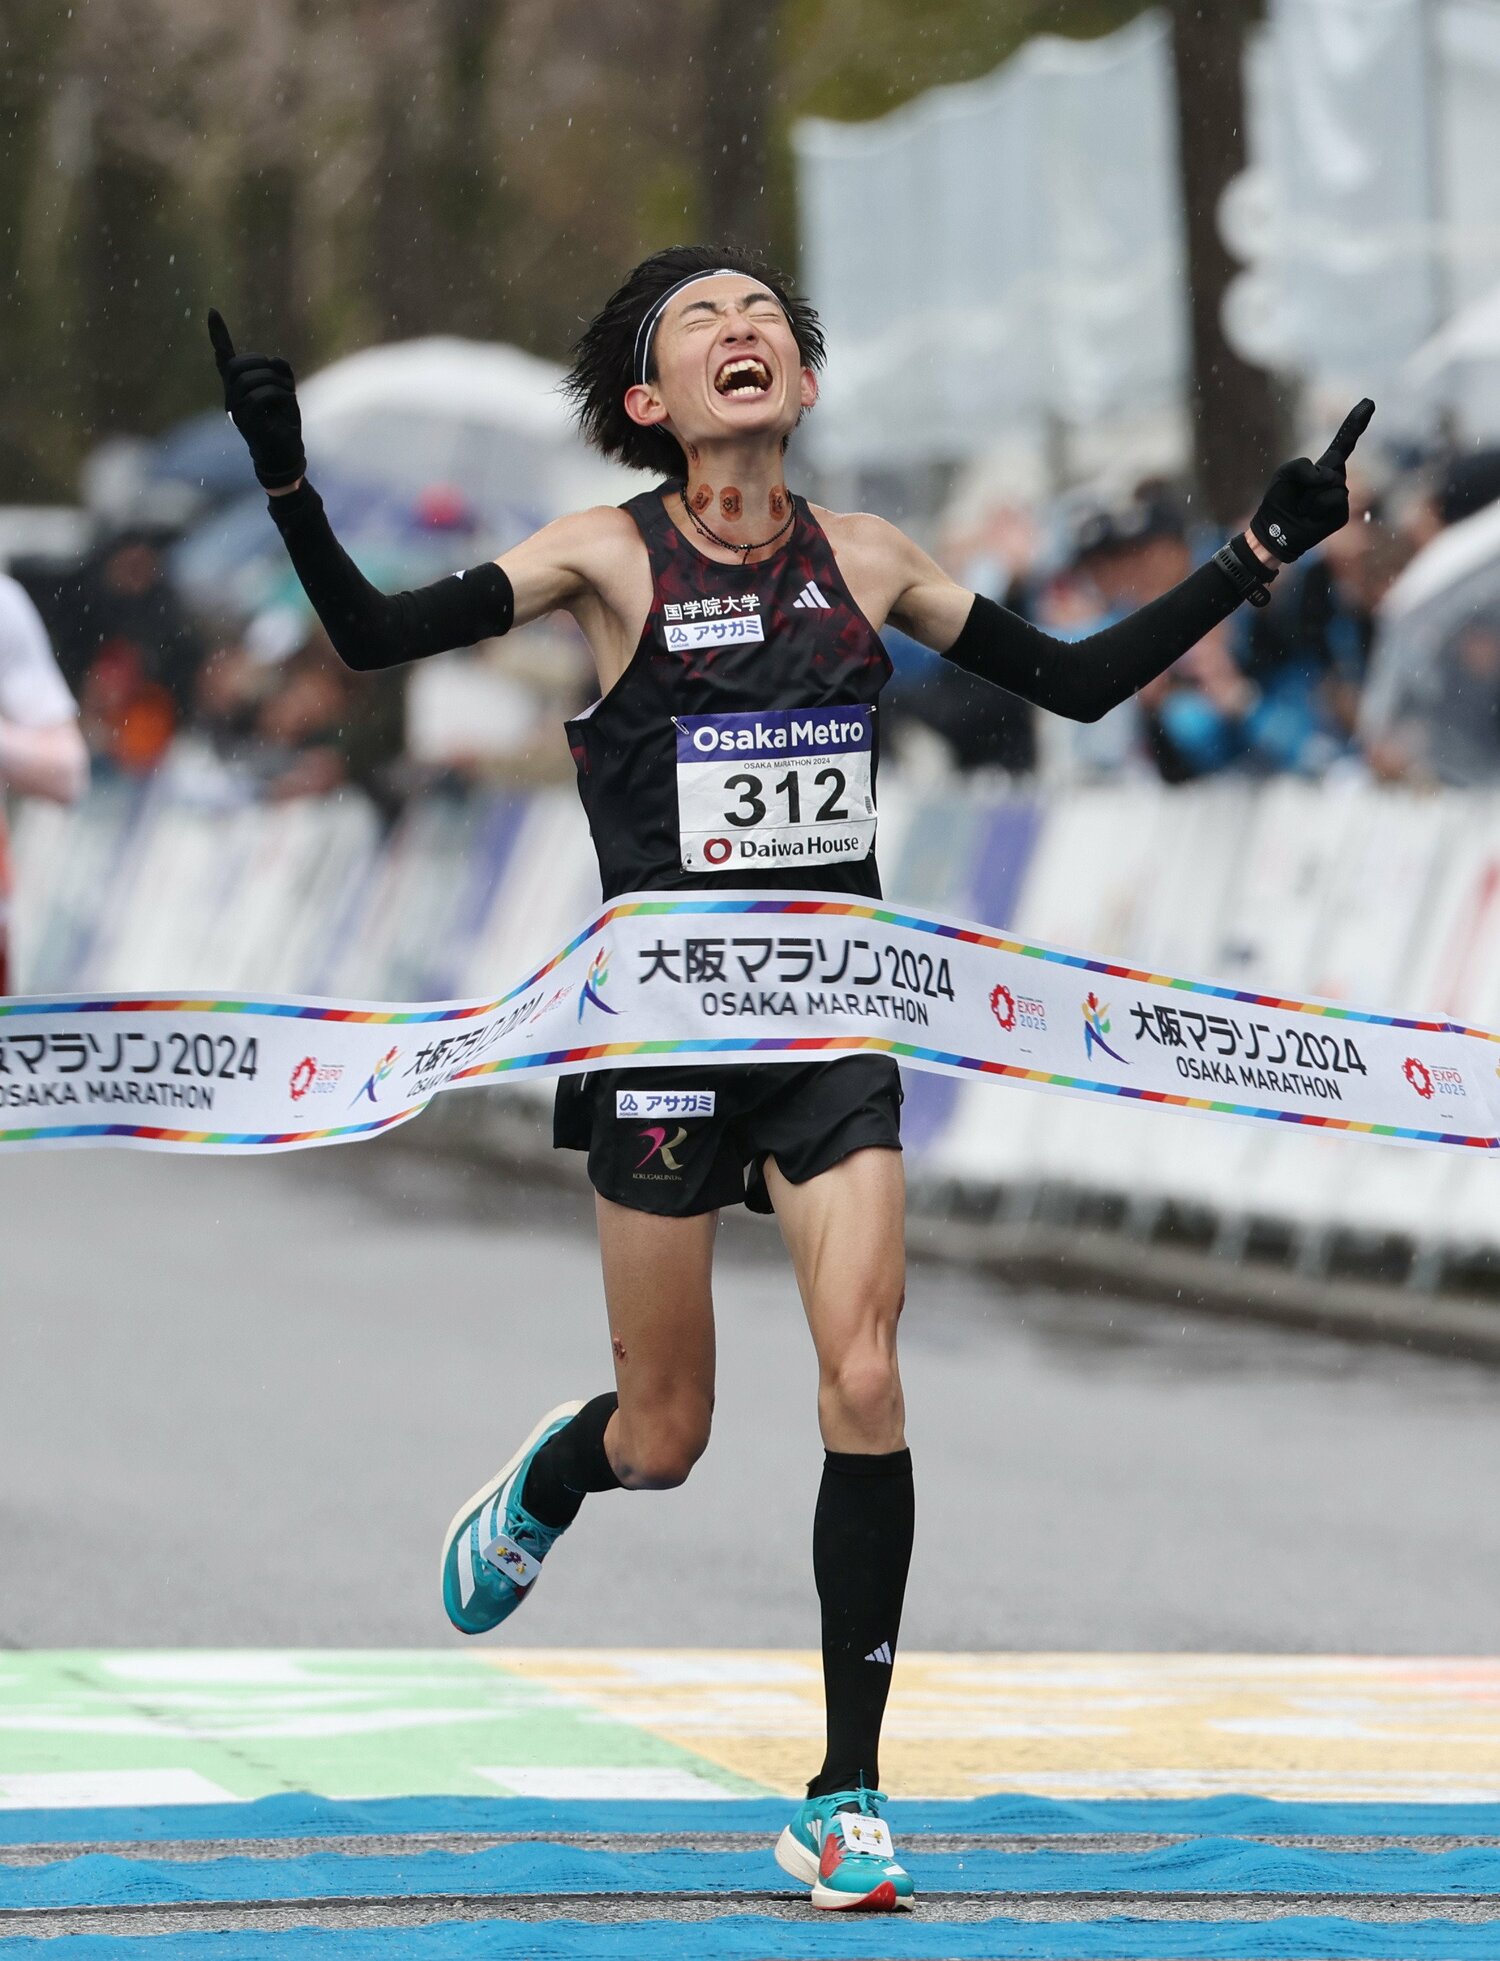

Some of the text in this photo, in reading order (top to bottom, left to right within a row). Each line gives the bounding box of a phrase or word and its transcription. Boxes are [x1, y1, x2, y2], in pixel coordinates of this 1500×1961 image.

[664, 593, 761, 621] 国学院大学
[694, 620, 760, 641] アサガミ
[744, 761, 772, 770] OSAKA
[813, 757, 831, 766] 2024
[723, 768, 848, 827] 312
[740, 836, 859, 858] Daiwa House
[638, 938, 955, 1001] 大阪マラソン2024
[702, 991, 929, 1026] OSAKA MARATHON
[1017, 1000, 1045, 1017] EXPO
[1020, 1014, 1047, 1031] 2025
[1129, 1001, 1368, 1076] 大阪マラソン2024
[1176, 1055, 1343, 1101] OSAKA MARATHON
[1432, 1070, 1462, 1084] EXPO
[86, 1081, 215, 1110] MARATHON
[1437, 1082, 1466, 1096] 2025
[646, 1095, 712, 1112] アサガミ
